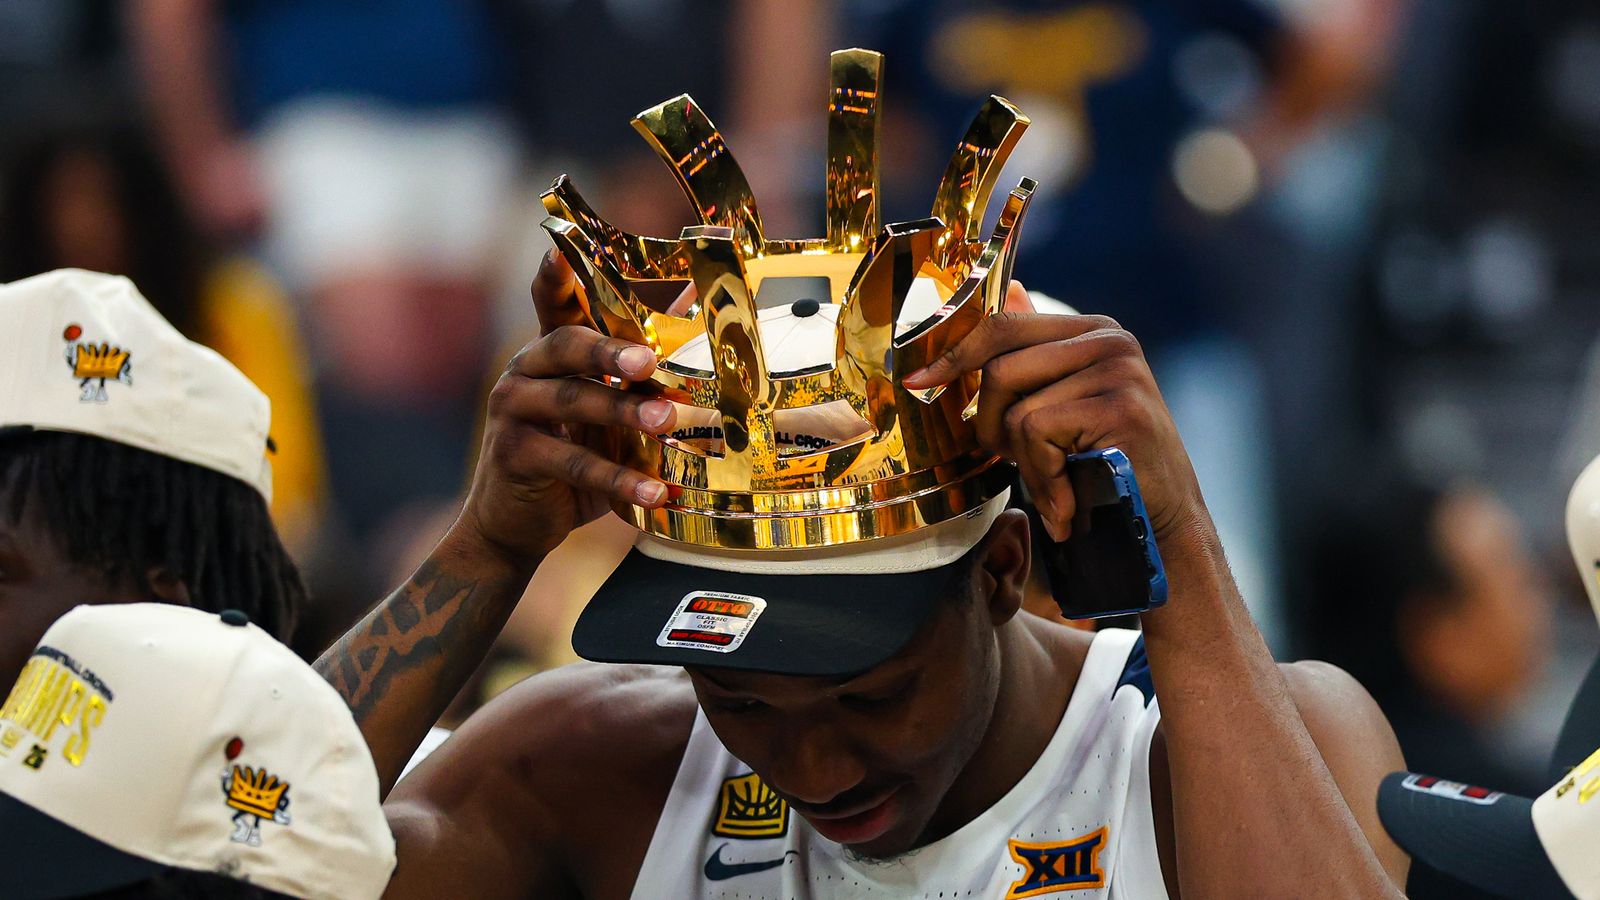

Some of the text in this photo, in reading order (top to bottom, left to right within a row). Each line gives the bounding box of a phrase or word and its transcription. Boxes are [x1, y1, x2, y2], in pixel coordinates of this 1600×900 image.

[794, 433, 837, 449] CROW
[692, 599, 747, 615] OTTO
[696, 614, 728, 622] CLASSIC
[1013, 834, 1102, 894] XII
